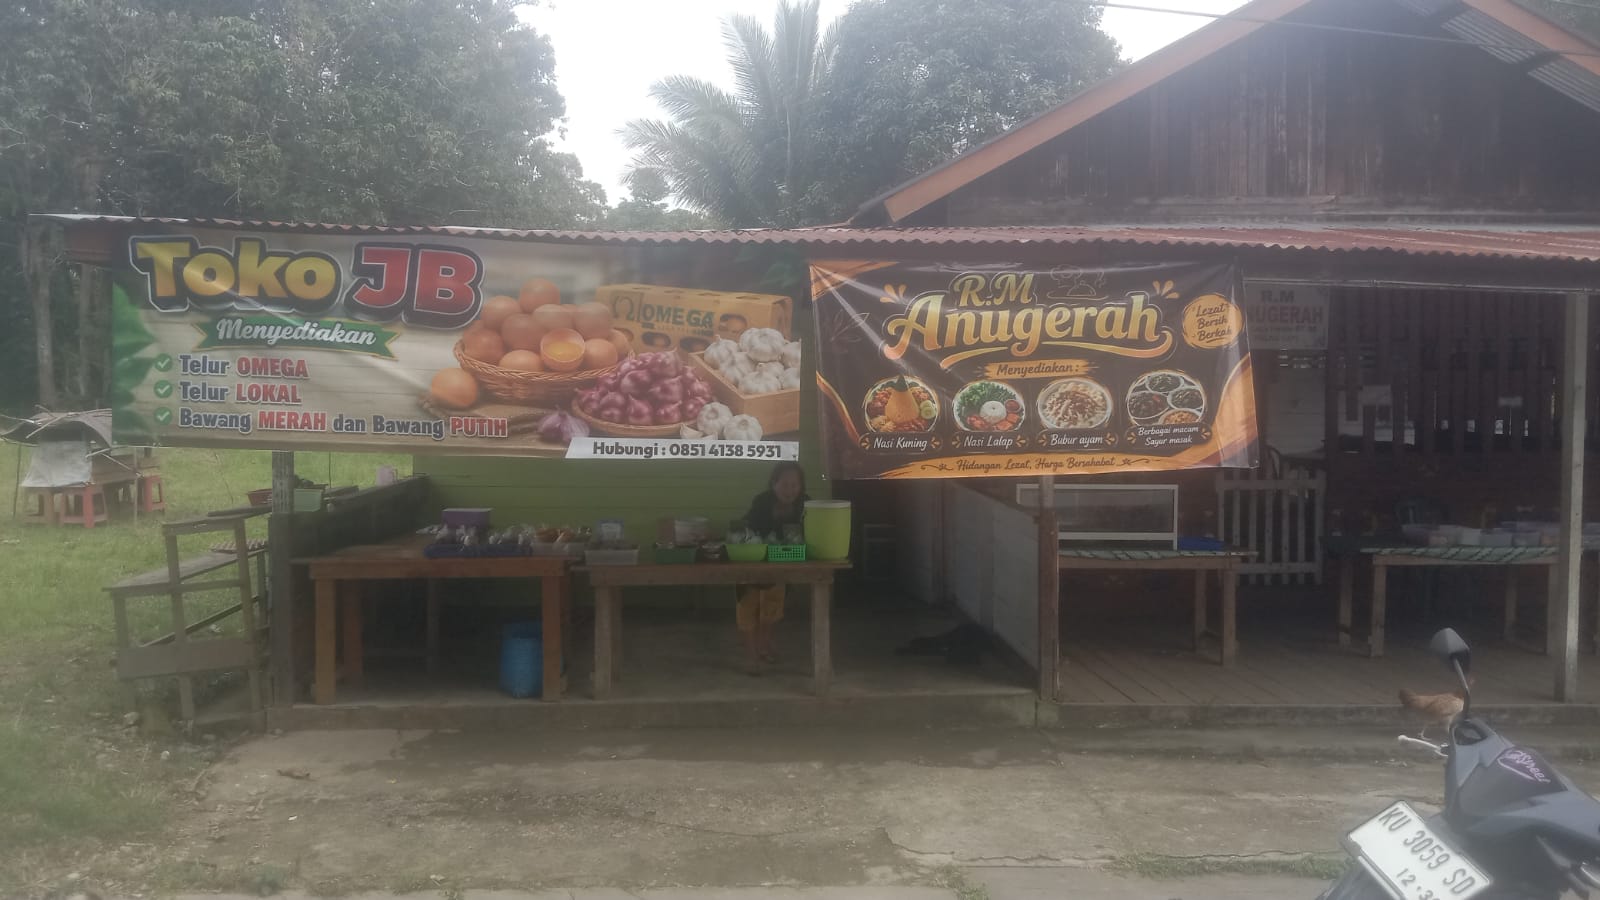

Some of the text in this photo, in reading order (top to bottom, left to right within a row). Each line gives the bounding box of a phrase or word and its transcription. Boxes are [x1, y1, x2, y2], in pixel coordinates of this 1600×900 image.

[133, 238, 480, 319] Toko JB
[954, 271, 1034, 307] R.M
[642, 303, 715, 328] OMEGA
[1196, 304, 1226, 317] Lezat
[216, 318, 377, 346] Menyediakan
[883, 290, 1173, 361] Anugerah
[178, 354, 309, 378] Telur OMEGA
[177, 381, 302, 404] Telur LOKAL
[178, 408, 508, 440] Bawang MERAH dan Bawang PUTIH
[1138, 426, 1171, 436] Berbagai
[593, 442, 658, 459] Hubungi
[669, 443, 705, 457] 0851
[708, 444, 744, 457] 4138
[747, 444, 781, 458] 5931
[873, 438, 928, 451] Nasi Kuning
[963, 434, 1013, 449] Nasi Lalap
[1050, 434, 1103, 448] Bubur ayam
[956, 460, 1001, 473] Hidangan
[1035, 459, 1064, 471] Harga
[1379, 807, 1413, 831] KU
[1403, 830, 1451, 870] 3059
